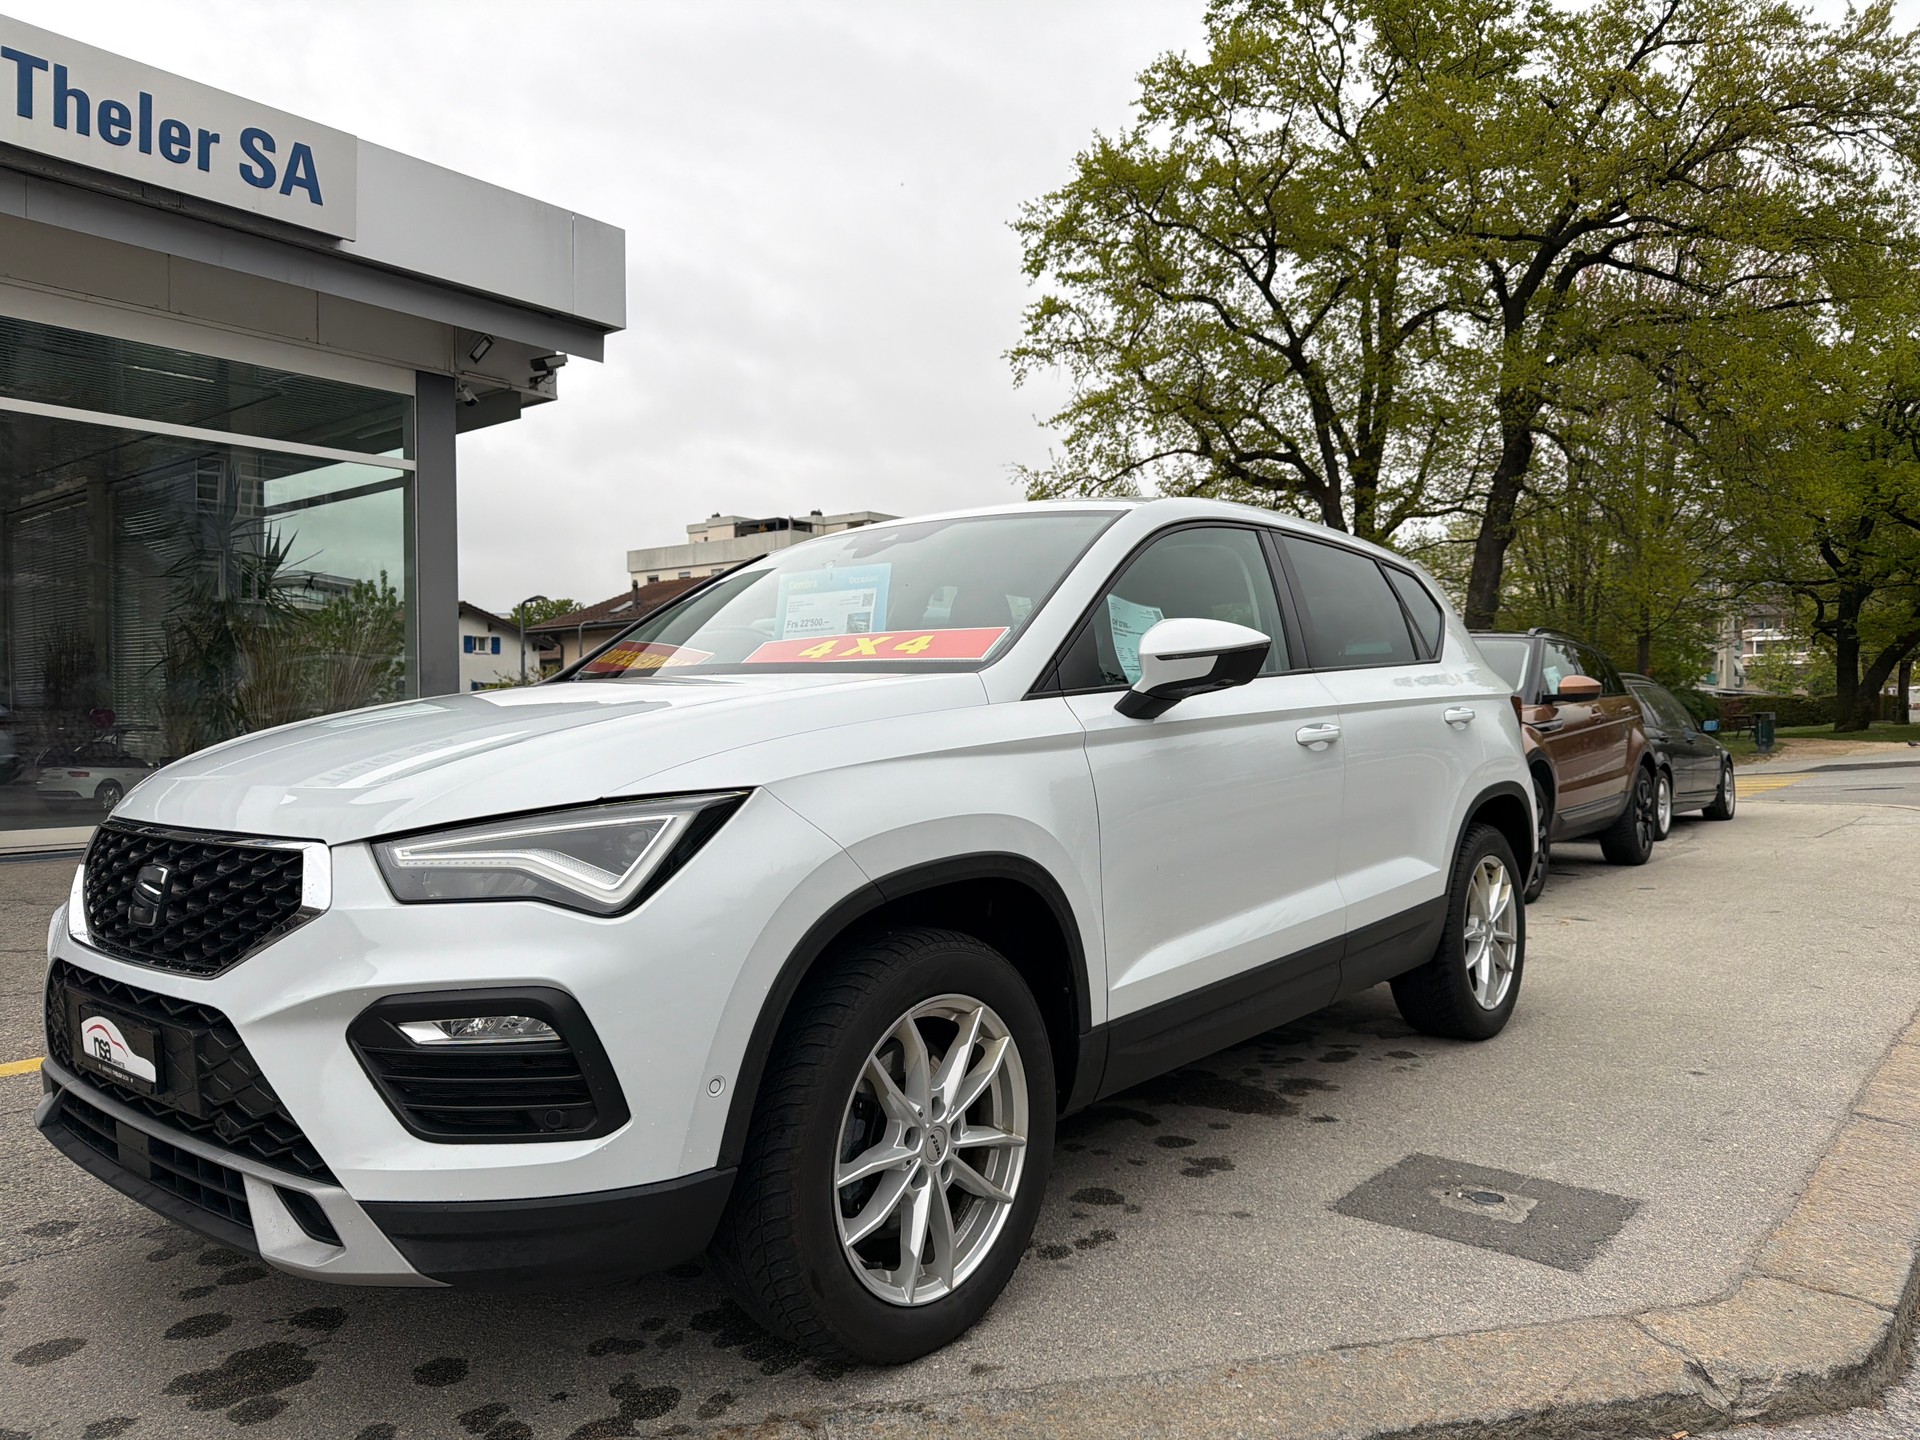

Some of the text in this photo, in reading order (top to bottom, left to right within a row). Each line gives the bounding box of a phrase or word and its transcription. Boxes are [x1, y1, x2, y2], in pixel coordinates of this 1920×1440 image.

[1, 46, 323, 206] Theler SA
[787, 620, 798, 628] Frs
[93, 1036, 112, 1062] nsa
